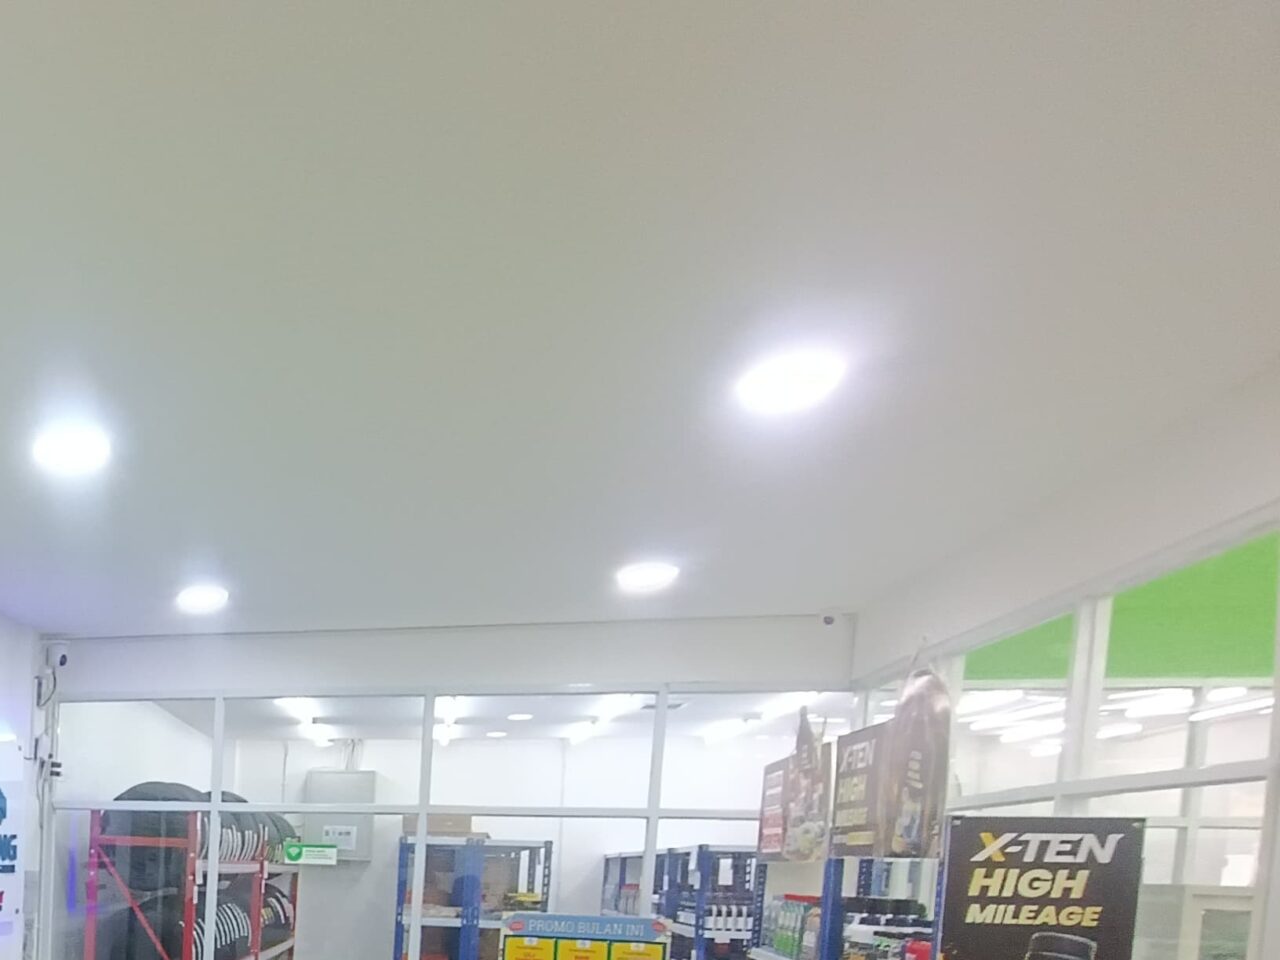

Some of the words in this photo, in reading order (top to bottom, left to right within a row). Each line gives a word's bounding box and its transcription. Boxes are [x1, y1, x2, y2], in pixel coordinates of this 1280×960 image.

[970, 832, 1124, 864] X-TEN
[968, 868, 1090, 899] HIGH
[528, 919, 573, 933] PROMO
[578, 922, 623, 936] BULAN
[626, 924, 645, 937] INI
[965, 904, 1103, 927] MILEAGE
